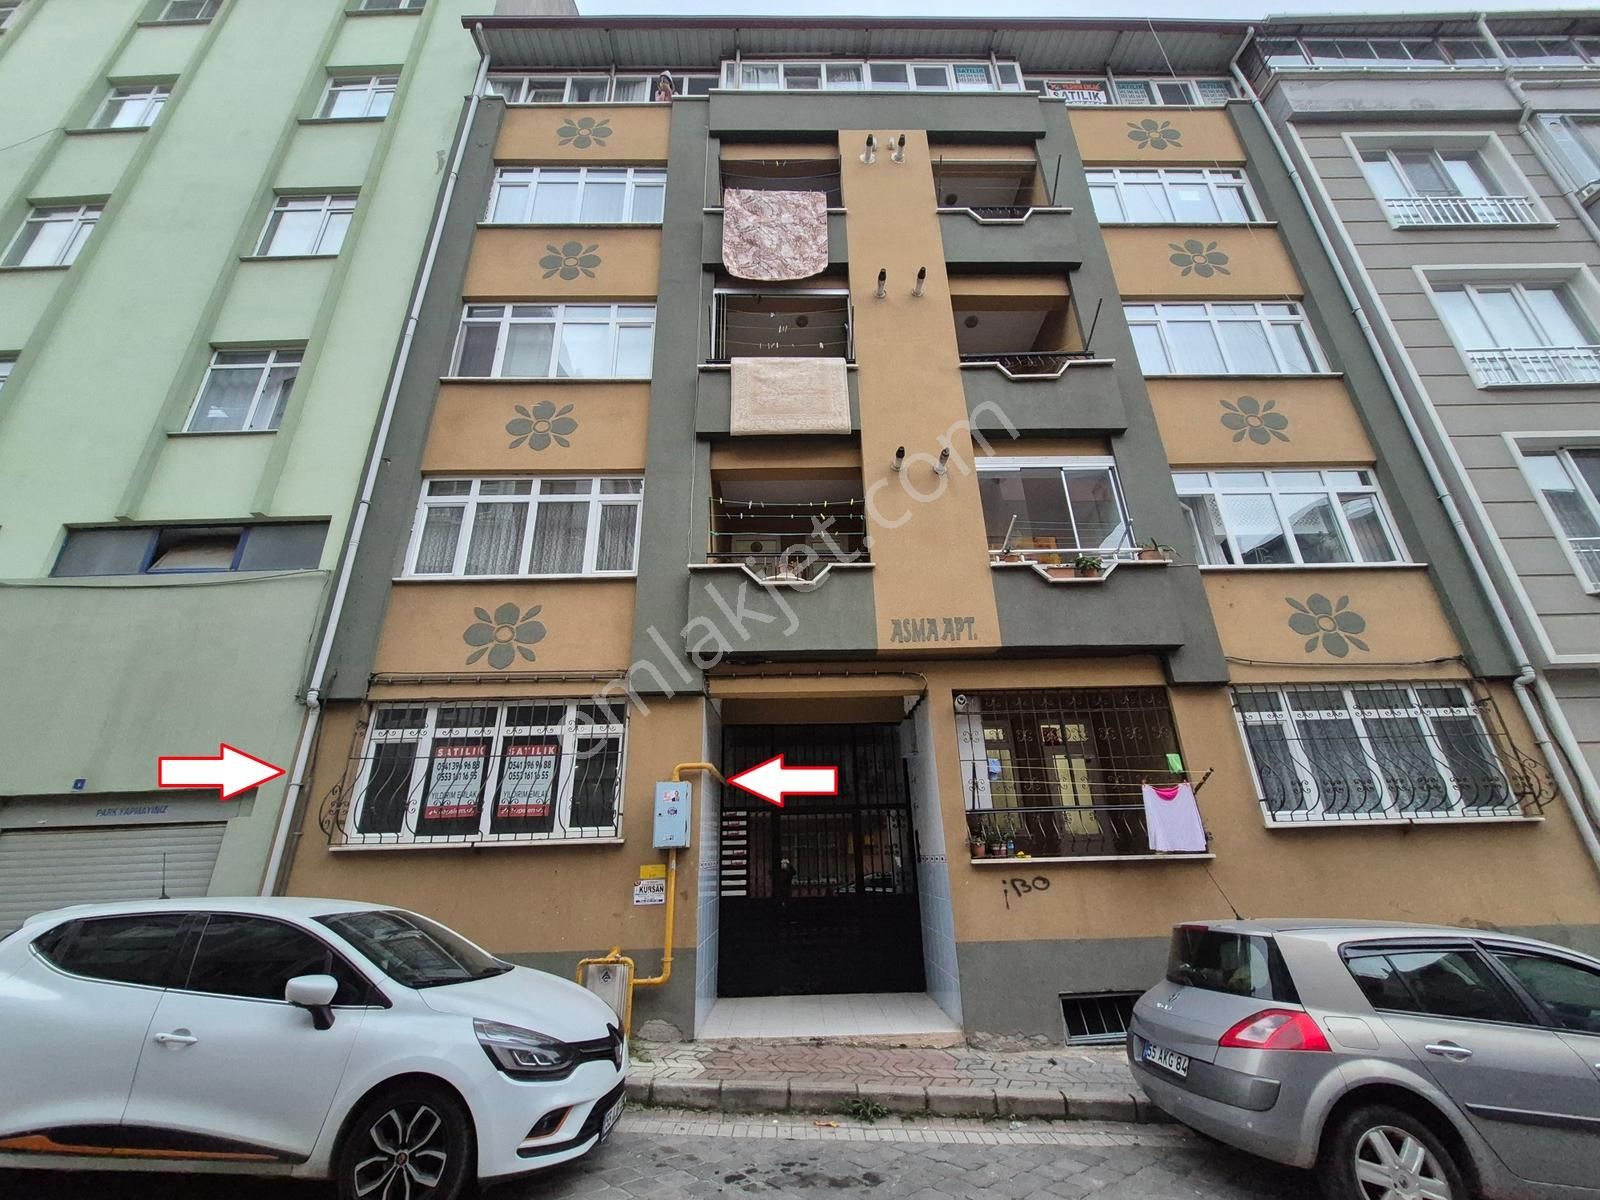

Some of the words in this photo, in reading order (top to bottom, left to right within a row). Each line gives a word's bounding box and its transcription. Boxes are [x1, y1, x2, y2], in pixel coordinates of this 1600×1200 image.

[1053, 90, 1102, 102] SATILIK
[890, 617, 940, 643] ASMA
[941, 616, 978, 641] APT.
[437, 746, 485, 758] SATILIK
[508, 745, 555, 756] SATILIK
[508, 761, 523, 770] 0541
[543, 760, 552, 769] 88
[541, 770, 549, 779] 55
[96, 807, 117, 818] PARK
[639, 885, 664, 893] KURSAN
[1148, 1043, 1157, 1059] 55
[1158, 1048, 1174, 1068] AKG
[1176, 1056, 1188, 1074] 84
